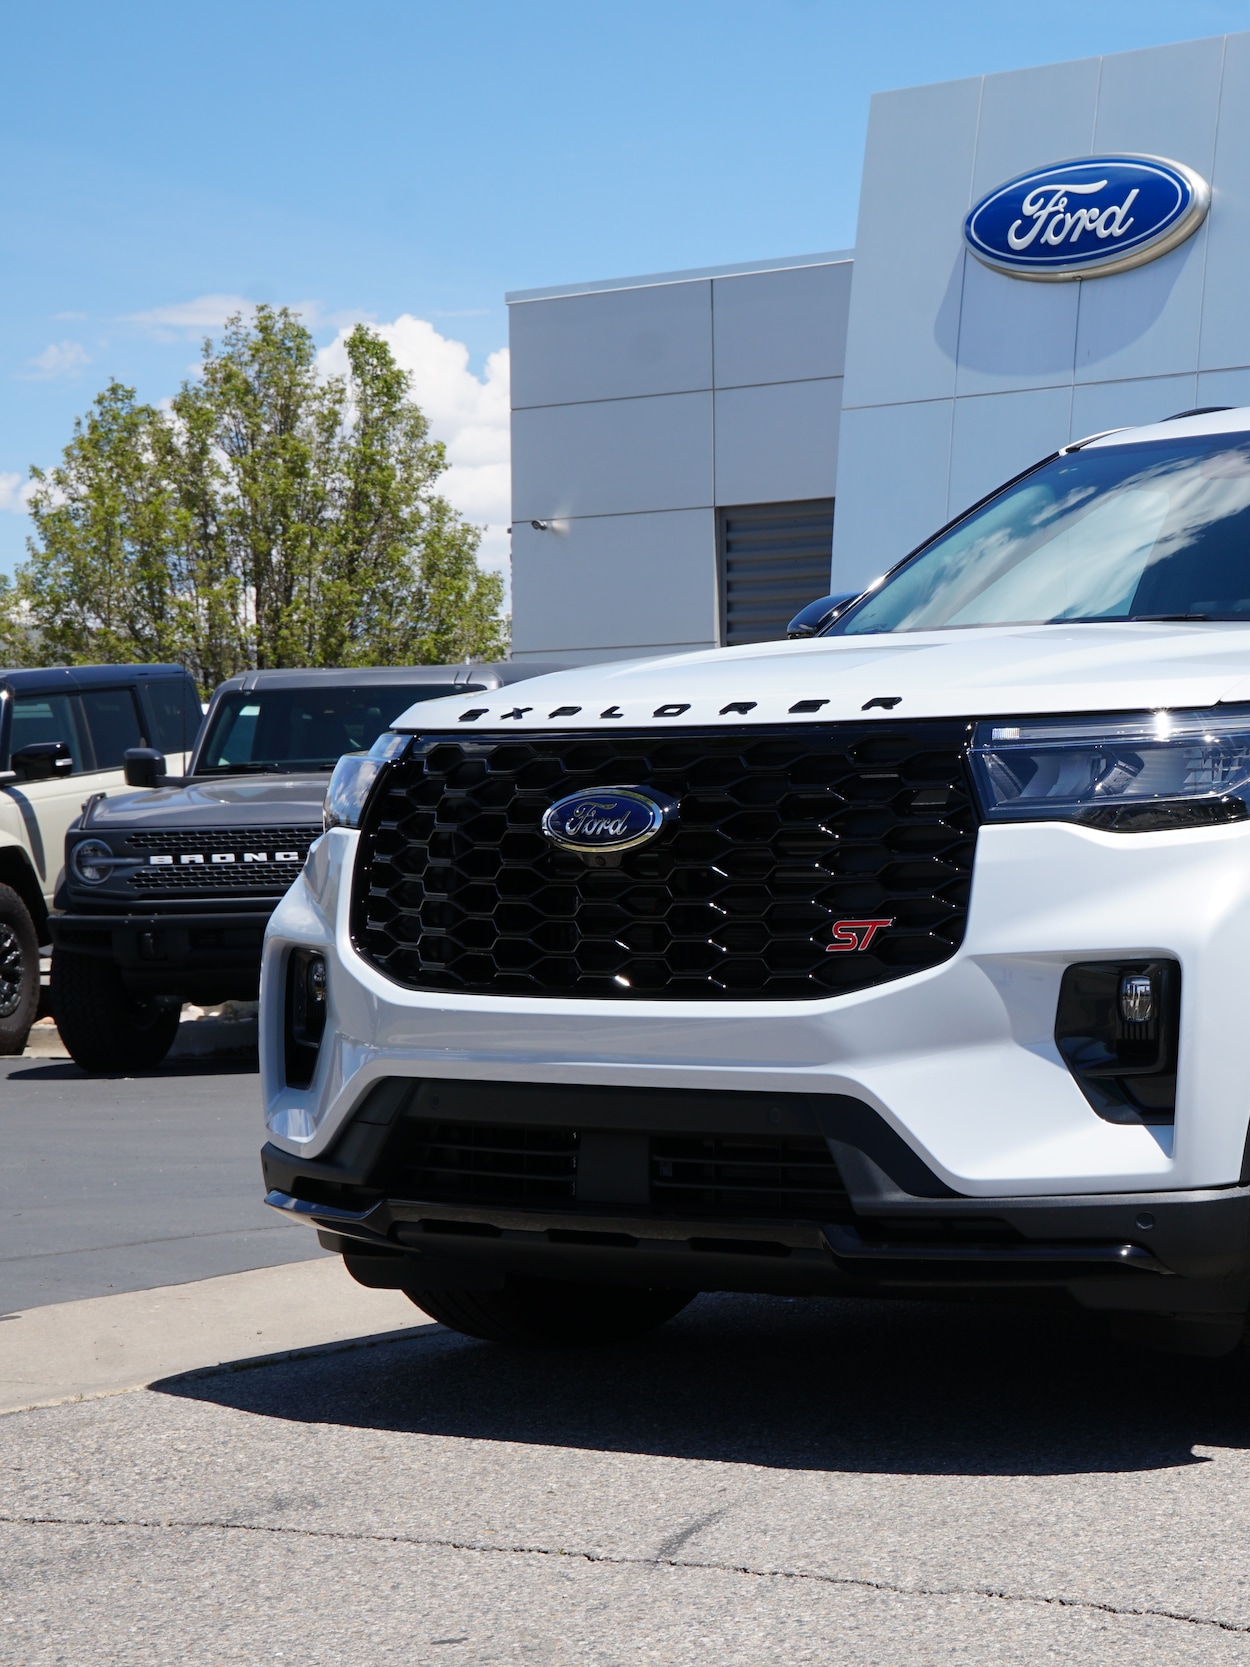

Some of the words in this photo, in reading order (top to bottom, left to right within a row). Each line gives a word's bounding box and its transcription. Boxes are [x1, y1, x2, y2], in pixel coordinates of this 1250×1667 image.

[1007, 179, 1140, 251] Ford
[457, 696, 903, 723] EXPLORER
[565, 801, 632, 836] Ford
[149, 851, 299, 865] BRONC
[825, 918, 894, 952] ST
